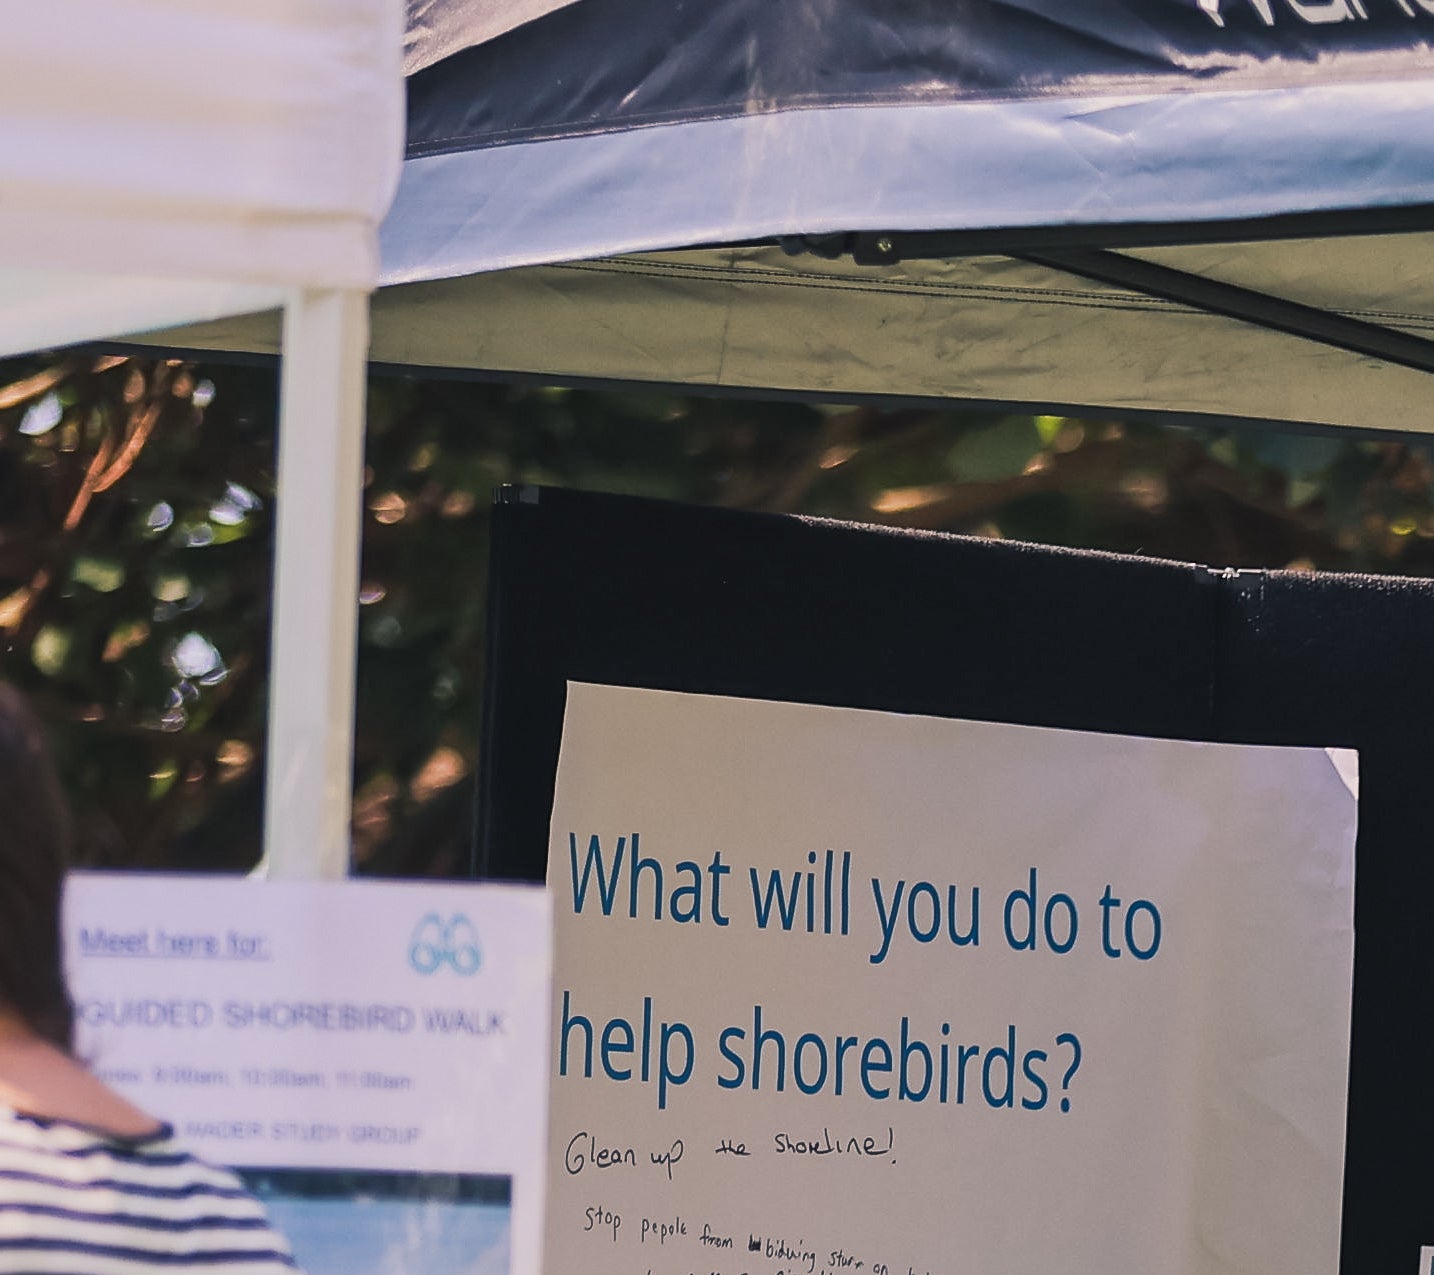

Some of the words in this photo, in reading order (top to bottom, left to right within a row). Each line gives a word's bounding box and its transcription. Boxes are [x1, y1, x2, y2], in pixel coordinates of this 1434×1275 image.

[568, 832, 730, 927] What
[748, 849, 852, 936] will
[868, 875, 981, 966] you
[1003, 866, 1080, 955] do
[1098, 883, 1163, 961] to
[79, 927, 148, 957] Meet
[158, 929, 219, 958] here
[82, 998, 213, 1032] GUIDED
[223, 1001, 417, 1035] SHOREBIRD
[424, 1005, 507, 1037] WALK
[557, 989, 696, 1111] help
[716, 1004, 1084, 1114] shorebirds?
[649, 1138, 685, 1181] up
[714, 1138, 752, 1157] the
[699, 1223, 734, 1250] from
